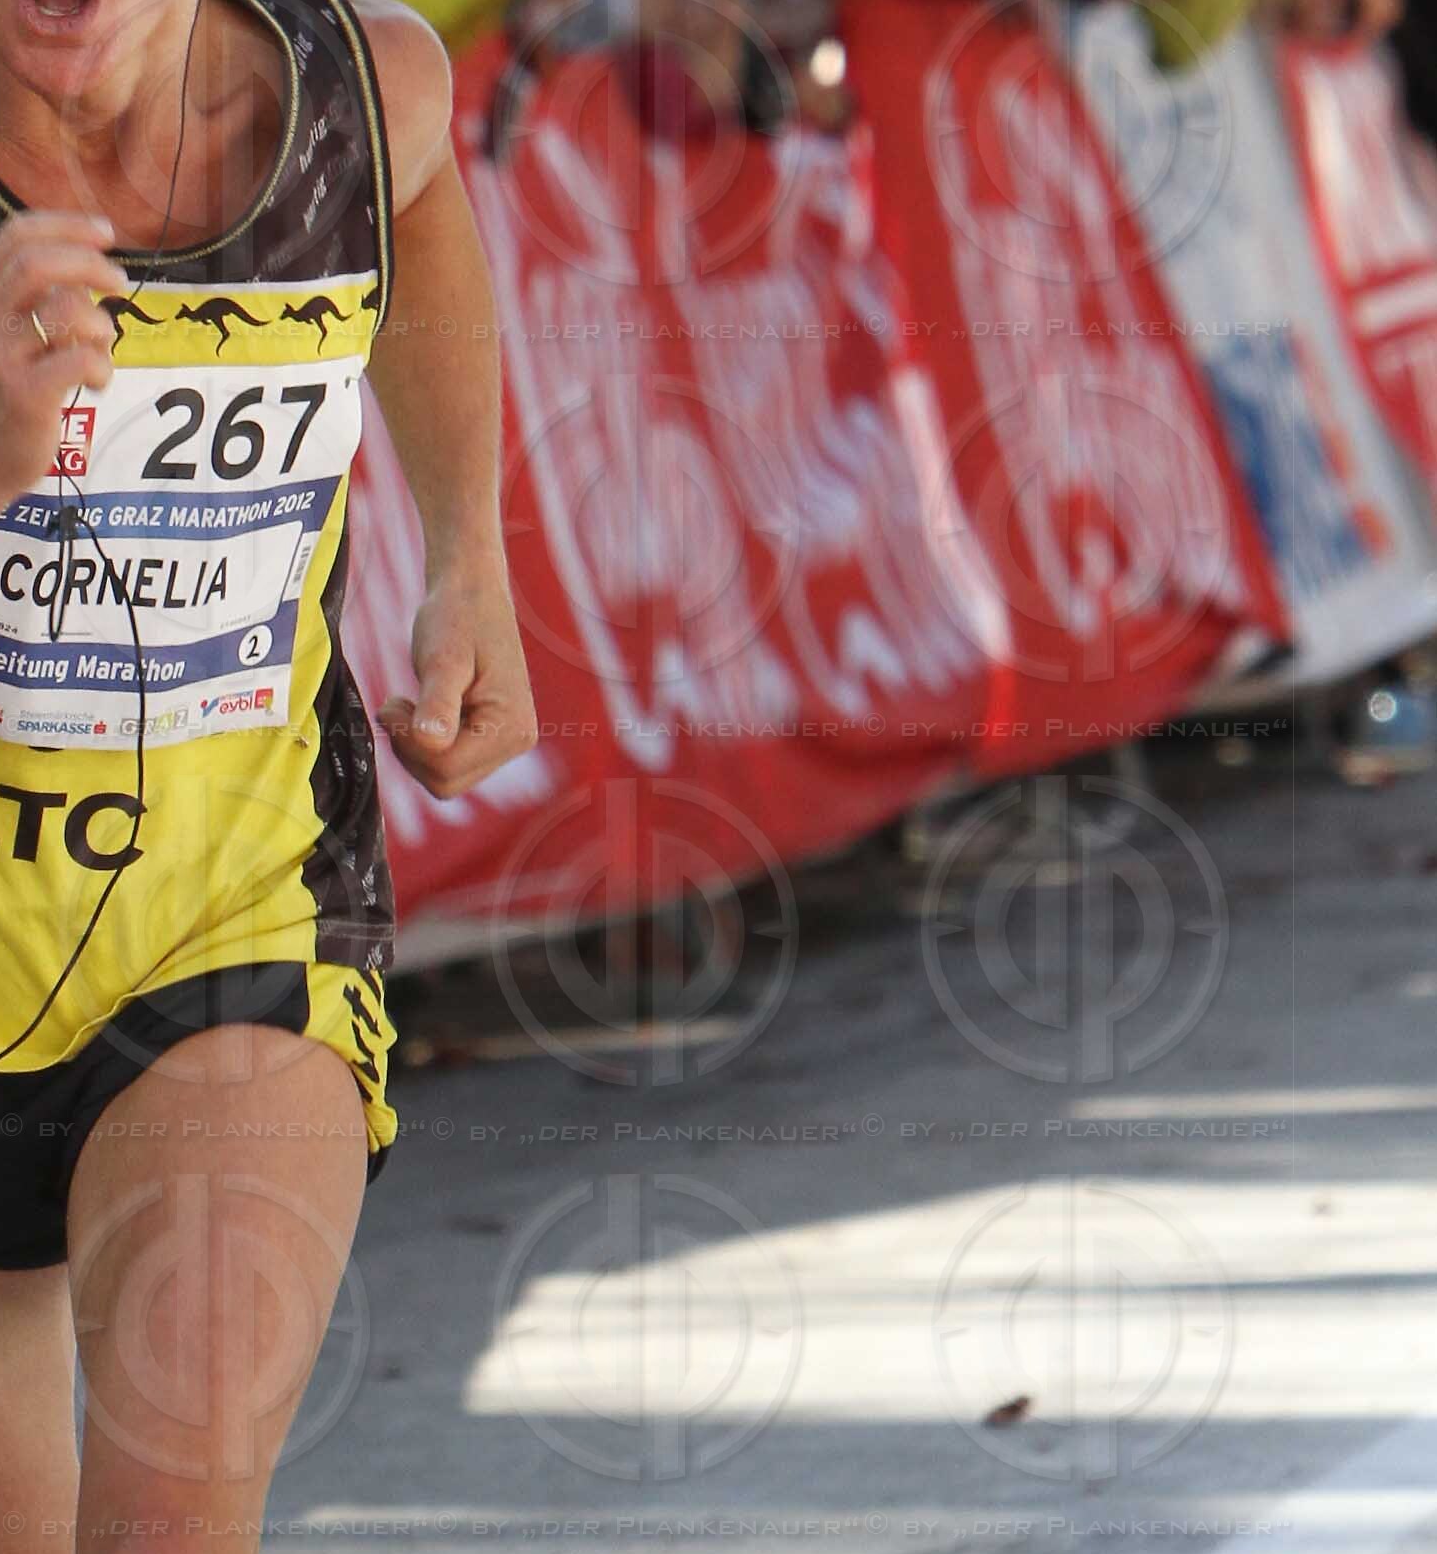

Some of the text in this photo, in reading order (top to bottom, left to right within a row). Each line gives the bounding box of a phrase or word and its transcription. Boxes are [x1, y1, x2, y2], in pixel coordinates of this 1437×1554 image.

[140, 382, 328, 481] 267
[108, 506, 162, 528] GRAZ
[168, 500, 272, 529] MARATHON
[272, 489, 317, 514] 2012
[0, 552, 229, 609] CORNELIA
[245, 635, 261, 659] 2
[17, 720, 92, 735] SPARKASSE
